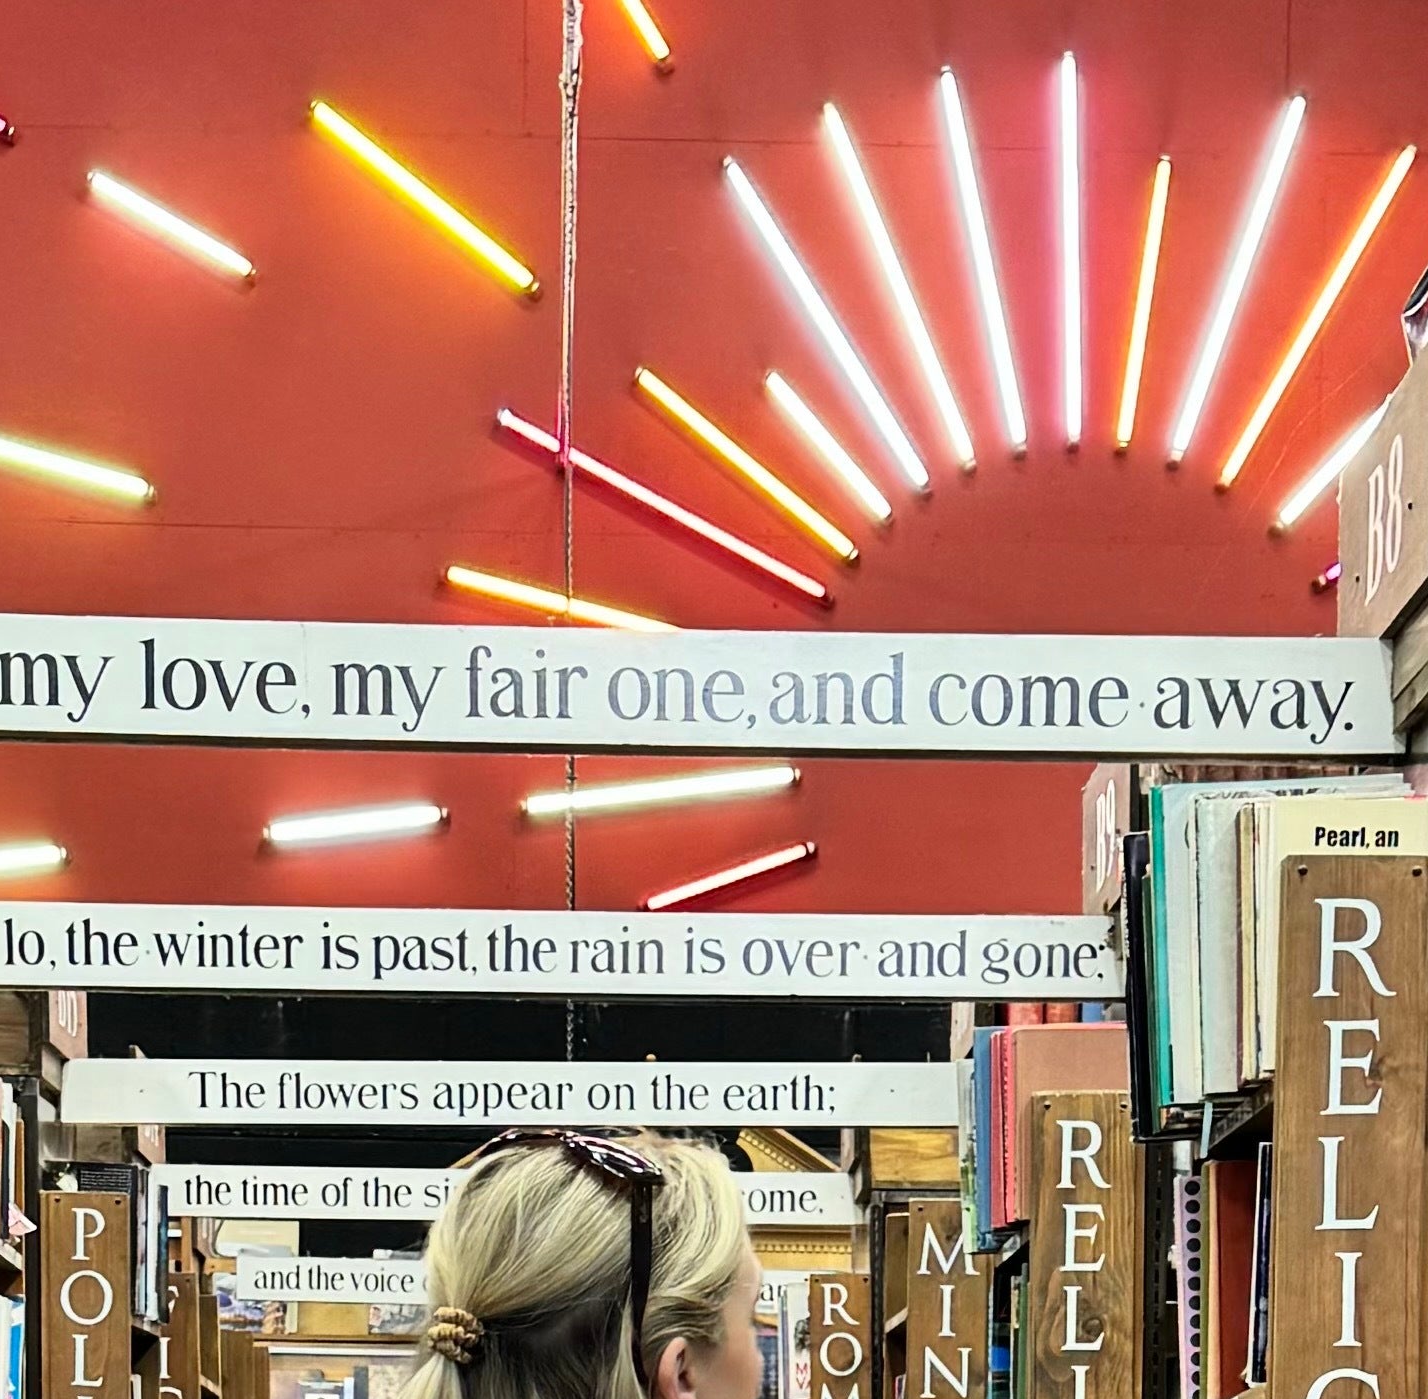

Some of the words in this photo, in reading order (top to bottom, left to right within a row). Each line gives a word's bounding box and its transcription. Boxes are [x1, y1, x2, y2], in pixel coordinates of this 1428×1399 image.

[1366, 434, 1403, 606] B8
[140, 637, 311, 722] love,
[331, 656, 444, 733] my
[464, 645, 588, 722] fair
[606, 662, 758, 730] one,
[768, 653, 907, 729] and
[928, 673, 1129, 730] come
[1151, 676, 1356, 745] away.
[1314, 826, 1368, 850] Pearl,
[1373, 828, 1400, 848] an
[4, 919, 57, 970] lo,
[66, 920, 139, 968] the
[153, 922, 304, 972] winter
[320, 921, 360, 970] is
[373, 930, 477, 980] past,
[487, 925, 557, 974] the
[570, 927, 665, 975] rain
[683, 926, 726, 977] is
[742, 935, 862, 979] over
[877, 929, 968, 980] and
[188, 1070, 266, 1110] The
[277, 1072, 419, 1111] flowers
[433, 1080, 573, 1118] appear
[587, 1080, 636, 1110] on
[651, 1075, 708, 1111] the
[722, 1075, 837, 1115] earth;
[184, 1178, 231, 1208] the
[241, 1178, 308, 1209] time
[321, 1178, 353, 1209] of
[362, 1179, 412, 1210] the
[740, 1185, 823, 1215] ome.
[254, 1268, 300, 1291] and
[308, 1268, 344, 1292] the
[352, 1269, 414, 1294] voice
